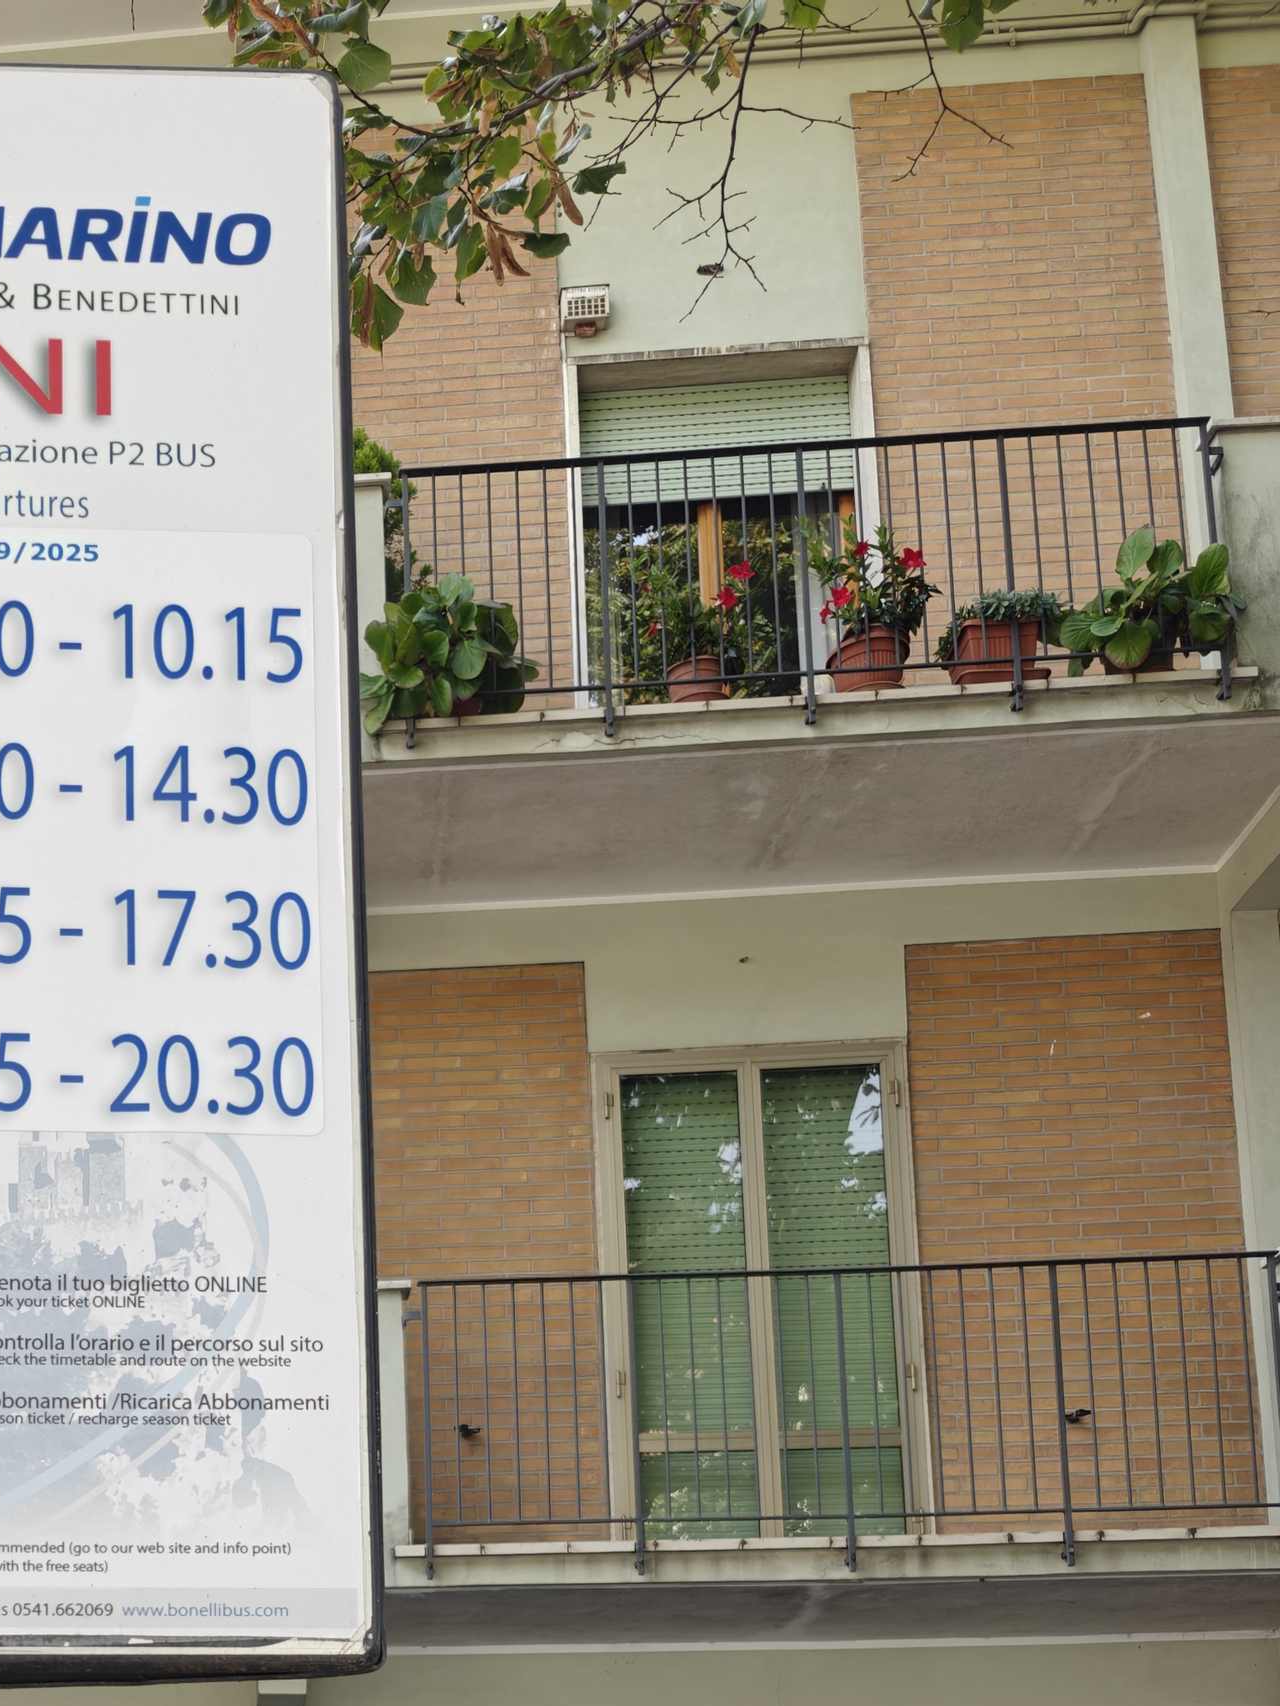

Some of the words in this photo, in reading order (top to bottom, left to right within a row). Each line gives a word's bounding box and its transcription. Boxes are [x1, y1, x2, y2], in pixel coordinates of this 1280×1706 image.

[109, 440, 144, 465] P2
[156, 442, 215, 467] BUS
[112, 603, 302, 683] 10.15
[113, 745, 307, 826] 14.30
[114, 888, 310, 970] 17.30
[109, 1033, 314, 1117] 20.30
[57, 1273, 67, 1291] il
[72, 1275, 105, 1292] tuo
[110, 1274, 190, 1296] biglietto
[194, 1275, 267, 1292] ONLINE
[16, 1297, 49, 1311] your
[50, 1295, 90, 1308] ticket
[92, 1295, 146, 1309] ONLINE
[139, 1338, 150, 1351] e
[155, 1333, 164, 1350] il
[171, 1338, 253, 1355] percorso
[258, 1334, 284, 1351] sul
[290, 1337, 323, 1352] sito
[23, 1352, 46, 1365] the
[50, 1352, 116, 1365] timetable
[119, 1353, 145, 1366] and
[149, 1355, 186, 1366] route
[189, 1356, 207, 1366] on
[211, 1353, 234, 1366] the
[237, 1354, 291, 1366] website
[197, 1392, 328, 1410] Abbonamenti
[68, 1541, 90, 1556] (go
[93, 1543, 107, 1553] to
[110, 1544, 133, 1553] our
[136, 1541, 164, 1553] web
[168, 1543, 191, 1553] site
[194, 1541, 219, 1553] and
[223, 1541, 248, 1554] info
[252, 1542, 291, 1556] point)
[13, 1601, 114, 1617] 0541.662069
[121, 1602, 288, 1616] www.bonellibus.com
